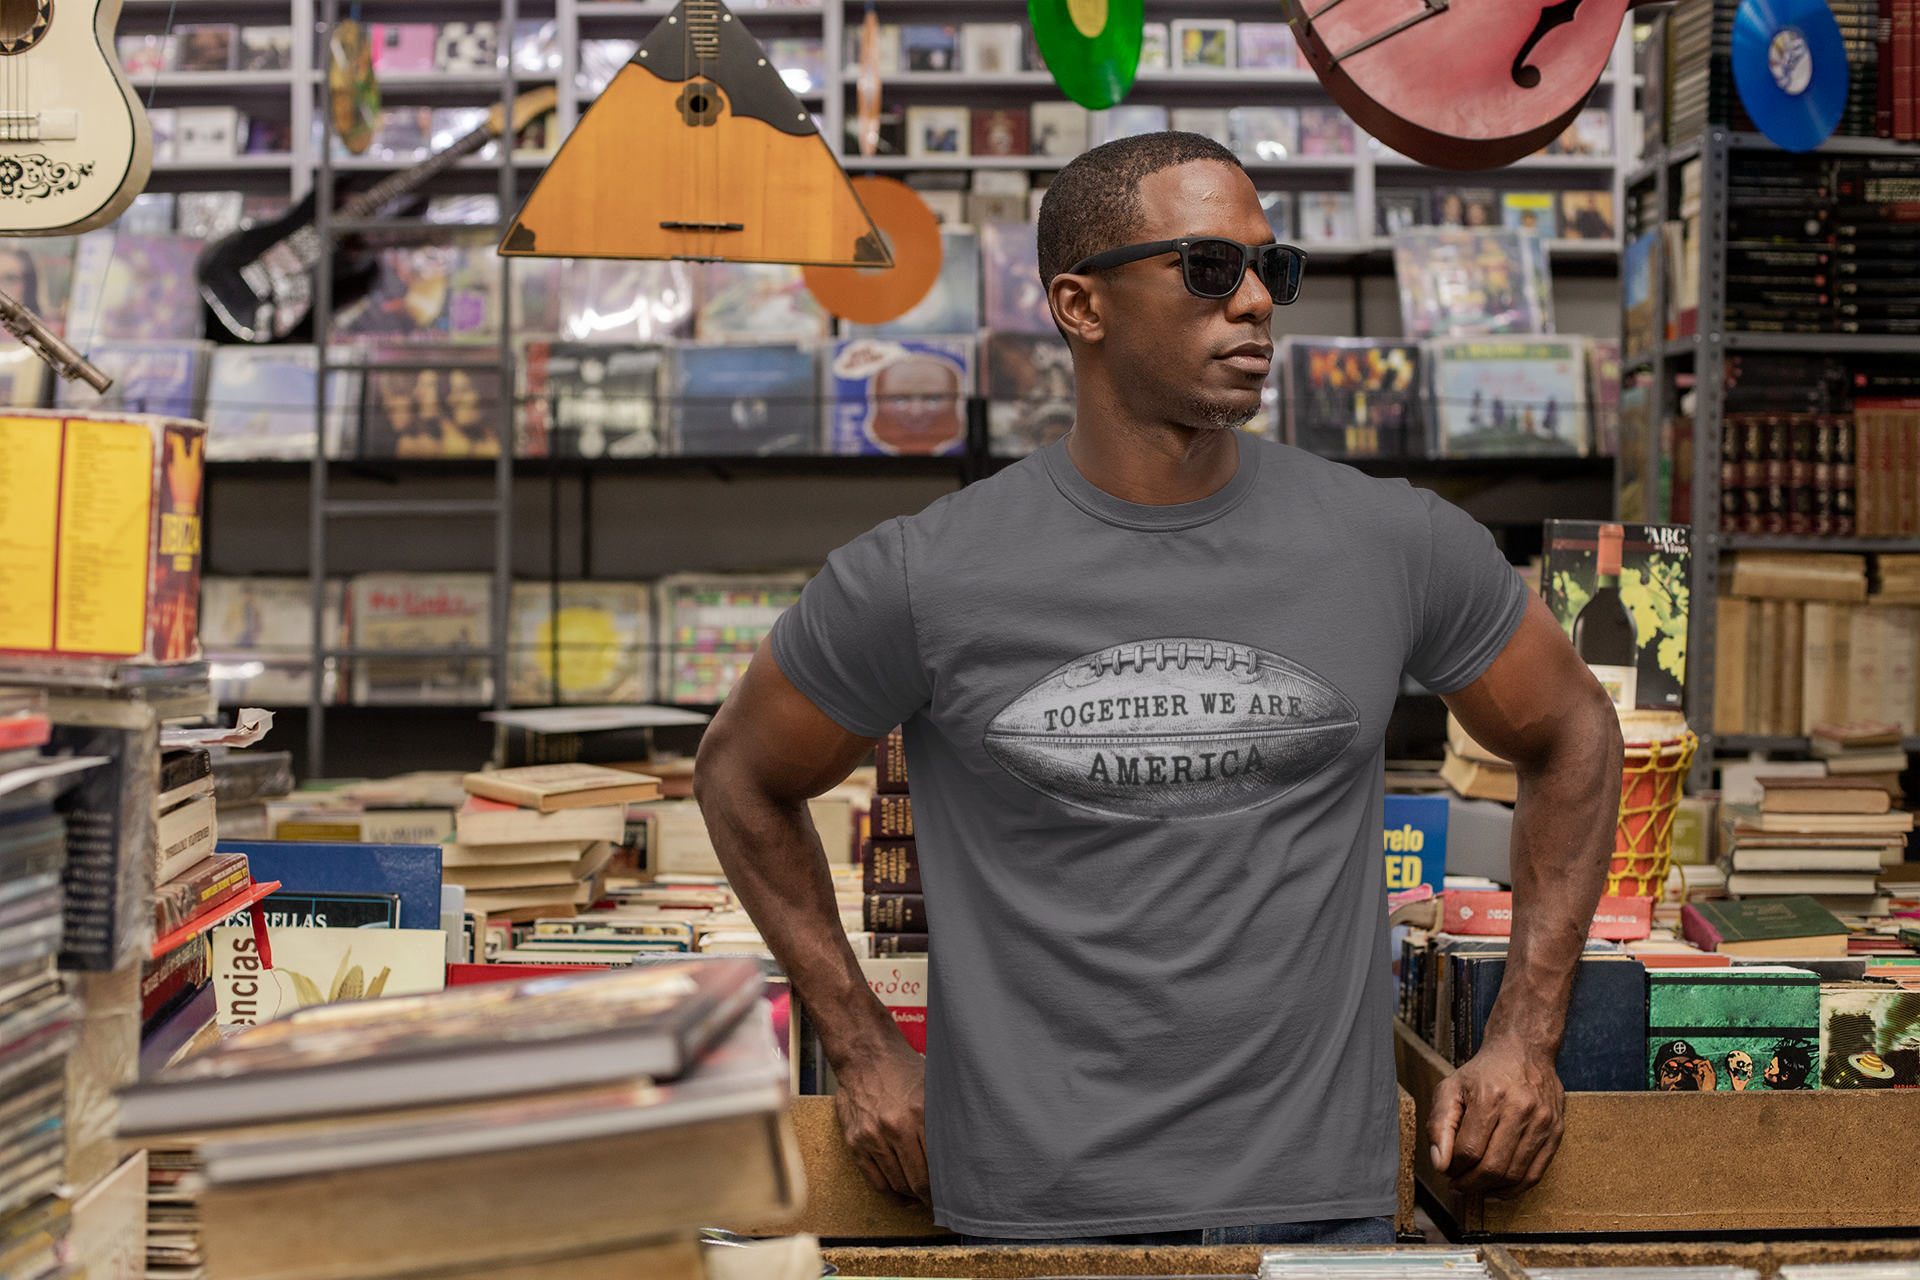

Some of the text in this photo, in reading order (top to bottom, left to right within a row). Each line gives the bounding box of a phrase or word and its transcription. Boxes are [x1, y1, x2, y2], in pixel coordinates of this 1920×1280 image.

[1044, 692, 1302, 731] TOGETHER WE ARE
[1087, 745, 1269, 787] AMERICA
